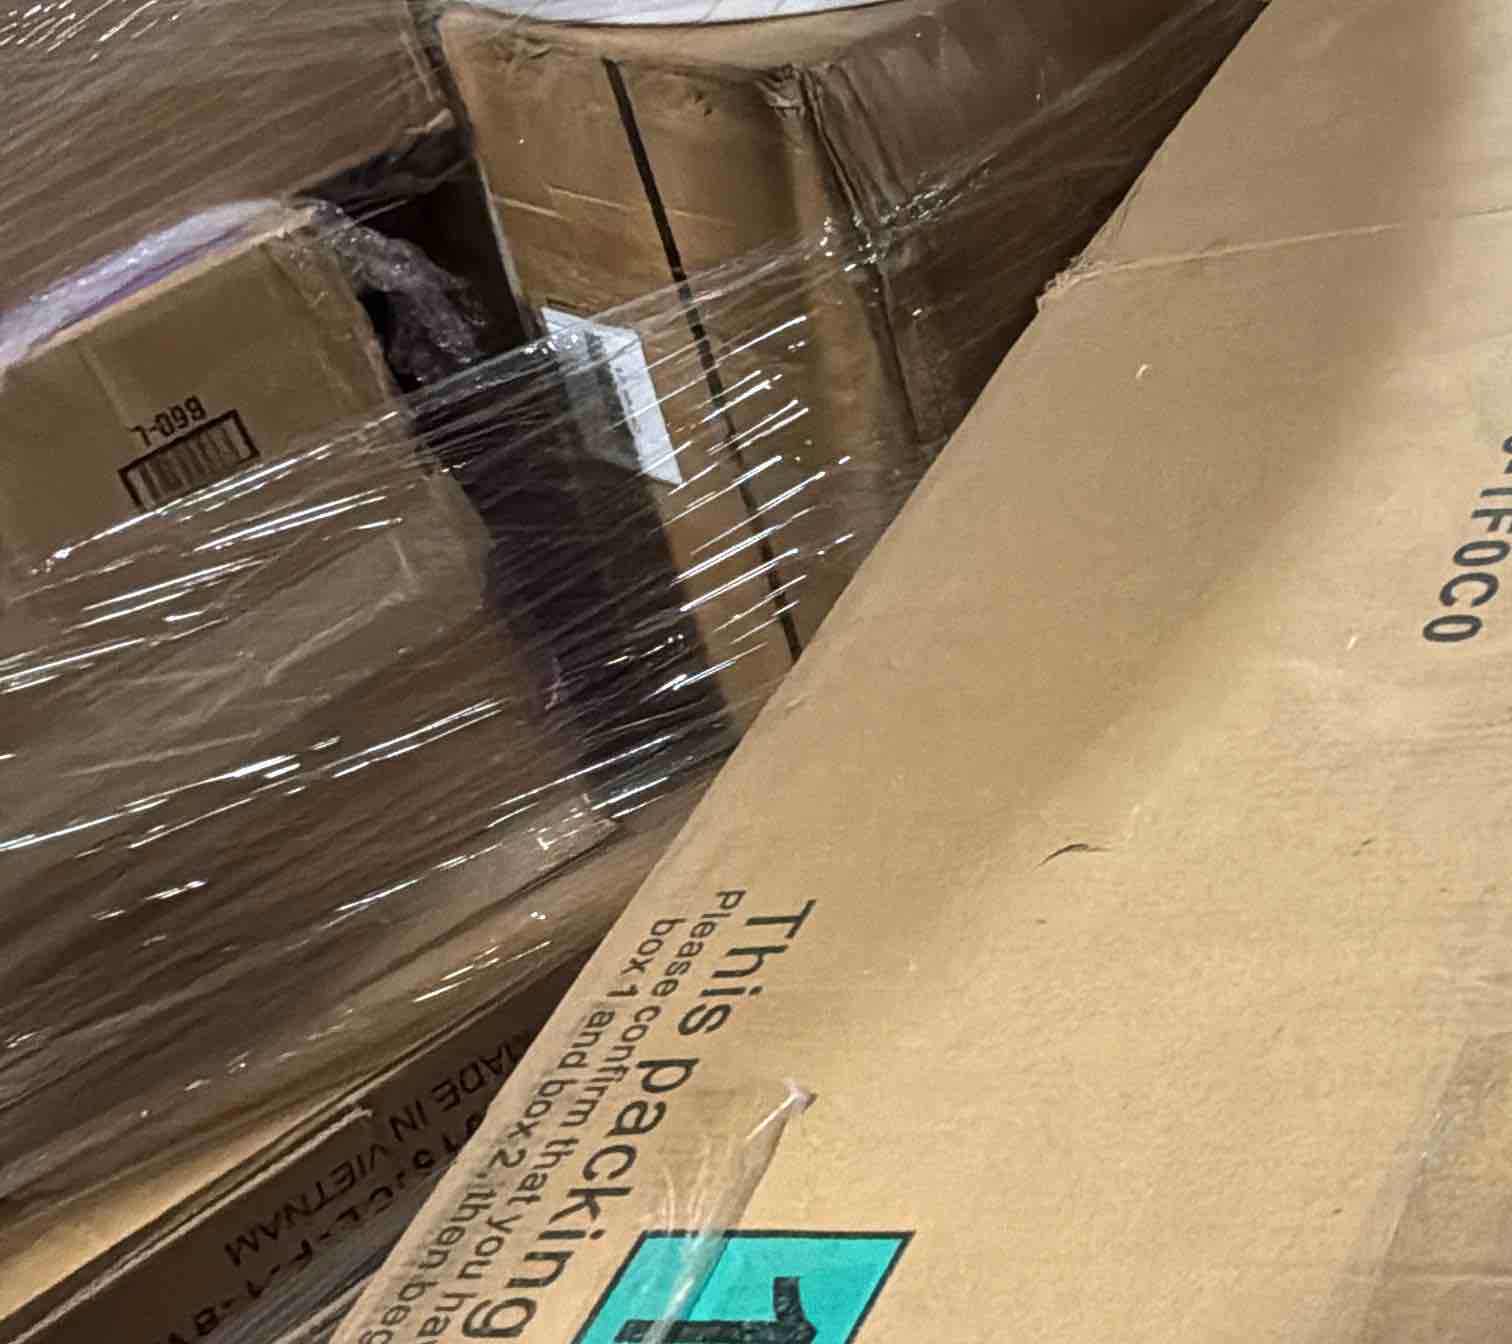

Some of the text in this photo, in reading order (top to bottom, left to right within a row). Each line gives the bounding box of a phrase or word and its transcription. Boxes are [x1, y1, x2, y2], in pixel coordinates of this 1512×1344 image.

[621, 917, 687, 976] box
[652, 889, 747, 997] Please
[678, 899, 816, 1036] This
[606, 984, 639, 999] 1
[558, 1009, 616, 1070] and
[560, 1006, 661, 1127] confirm
[388, 1099, 430, 1144] IN
[507, 1077, 578, 1141] box
[222, 1143, 388, 1268] VIETNAM
[462, 1058, 700, 1339] packing
[516, 1138, 579, 1206] that
[419, 1188, 497, 1269] then
[458, 1213, 523, 1280] you
